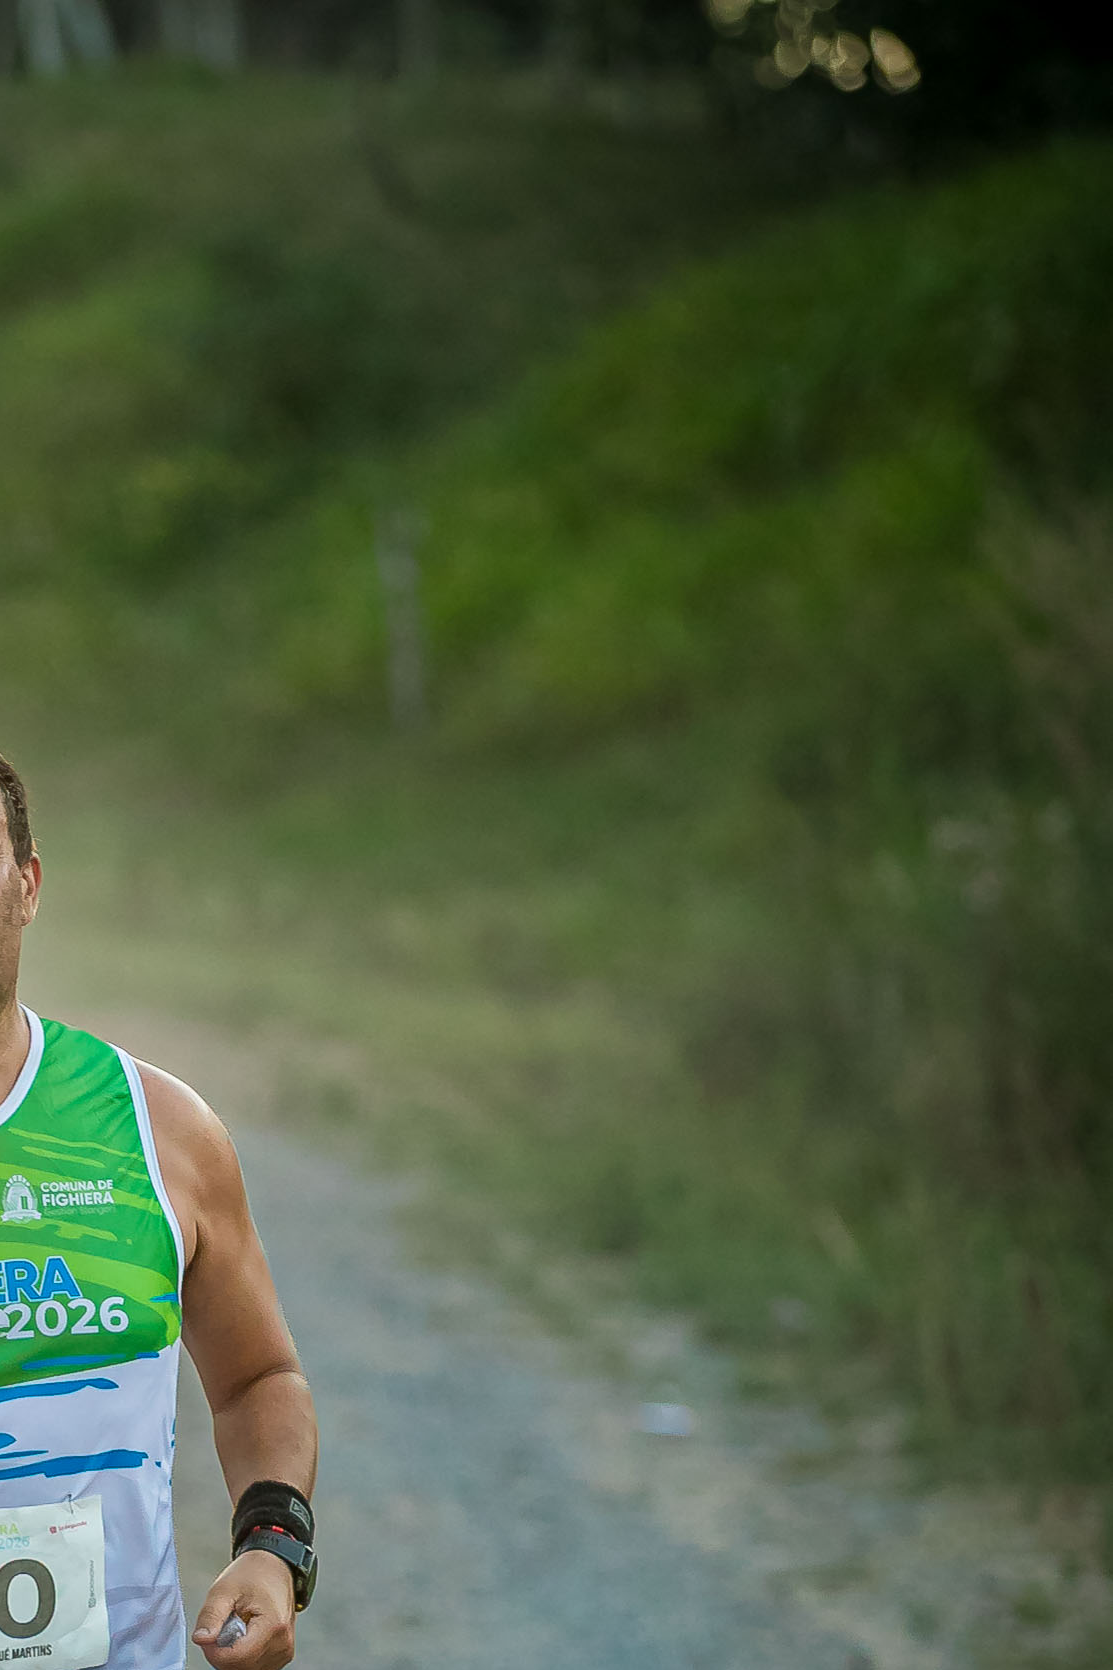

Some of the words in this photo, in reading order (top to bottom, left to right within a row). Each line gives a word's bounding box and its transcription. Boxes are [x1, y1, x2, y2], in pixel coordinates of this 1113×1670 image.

[40, 1180, 95, 1193] COMUNA
[97, 1179, 114, 1190] DE
[41, 1191, 115, 1207] FIGHIERA
[11, 1644, 53, 1660] MARTINS
